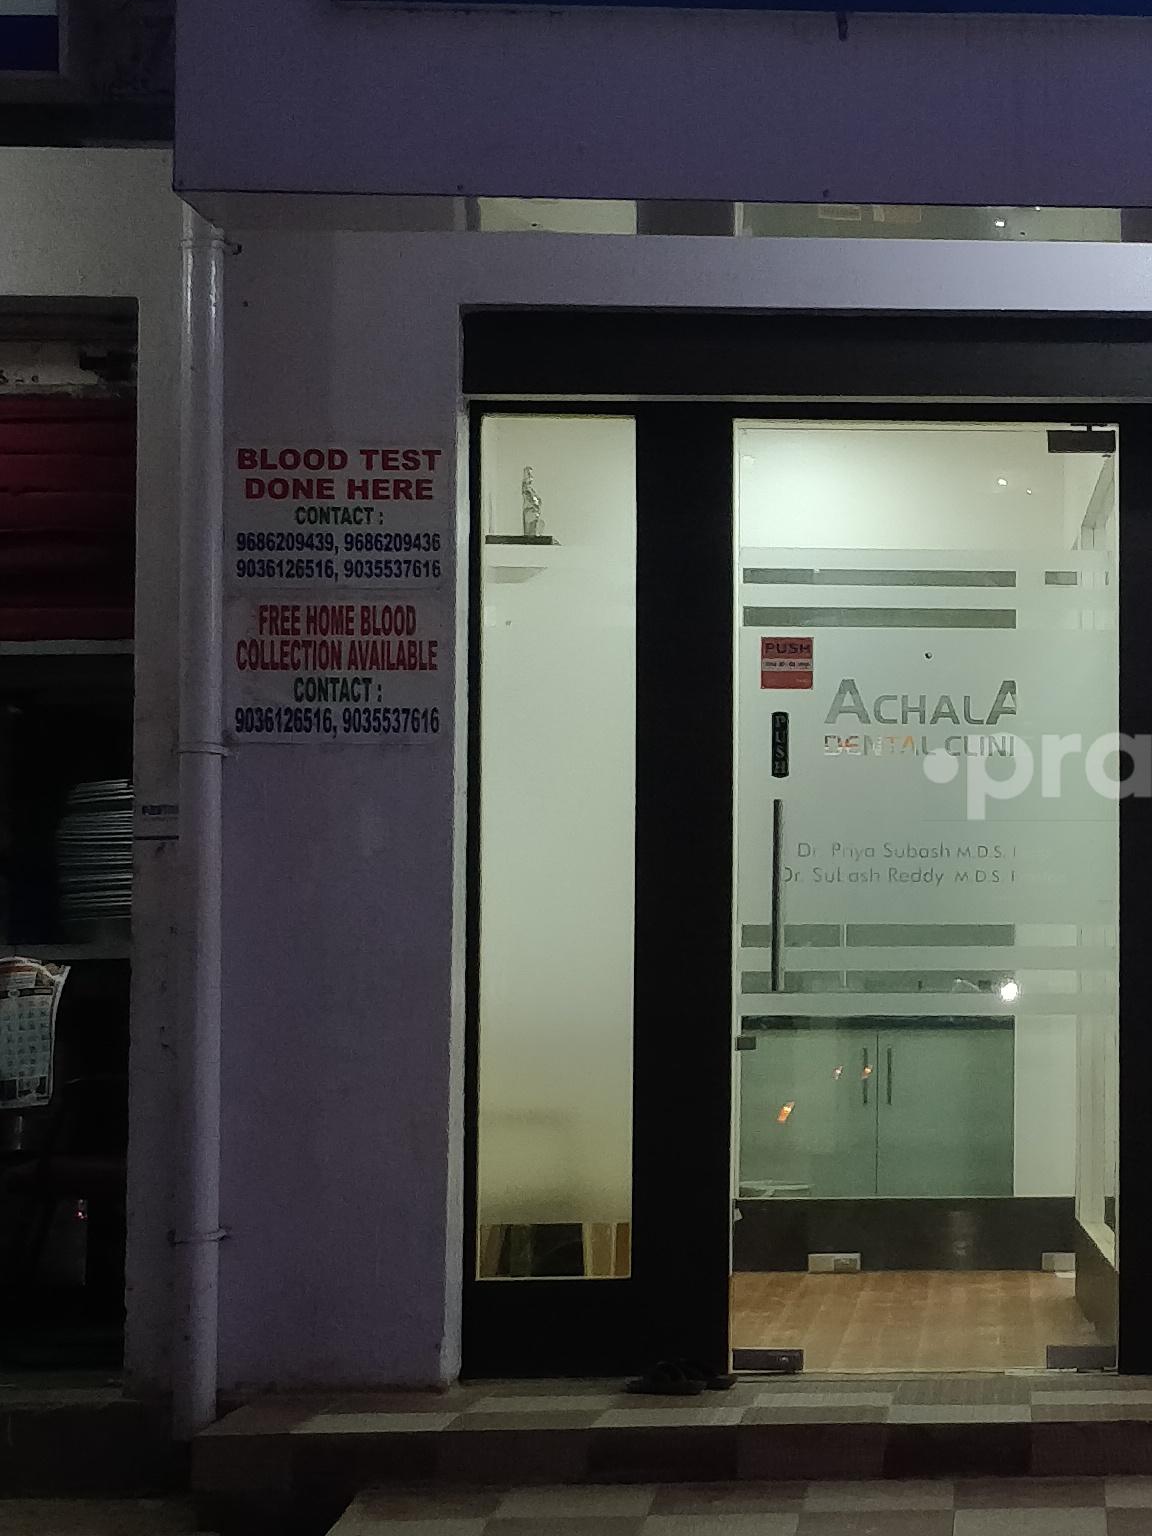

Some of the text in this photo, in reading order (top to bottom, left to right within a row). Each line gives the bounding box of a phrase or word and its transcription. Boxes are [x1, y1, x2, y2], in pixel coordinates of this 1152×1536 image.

[237, 448, 442, 471] BLOOD TEST
[245, 478, 433, 500] DONE HERE
[296, 506, 374, 525] CONTACT
[236, 532, 441, 554] 9686209439, 9686209436
[236, 559, 441, 582] 9036126516, 9035537616
[259, 605, 416, 636] FREE HOME BLOOD
[236, 639, 438, 671] COLLECTION AVAILABLE
[764, 642, 812, 654] PUSH
[293, 677, 372, 703] CONTACT
[824, 678, 1017, 725] ACHALA
[235, 707, 439, 739] 9036126516, 9035537616
[944, 735, 1015, 757] CLINI
[883, 841, 951, 858] Subash
[888, 867, 945, 886] Reddy
